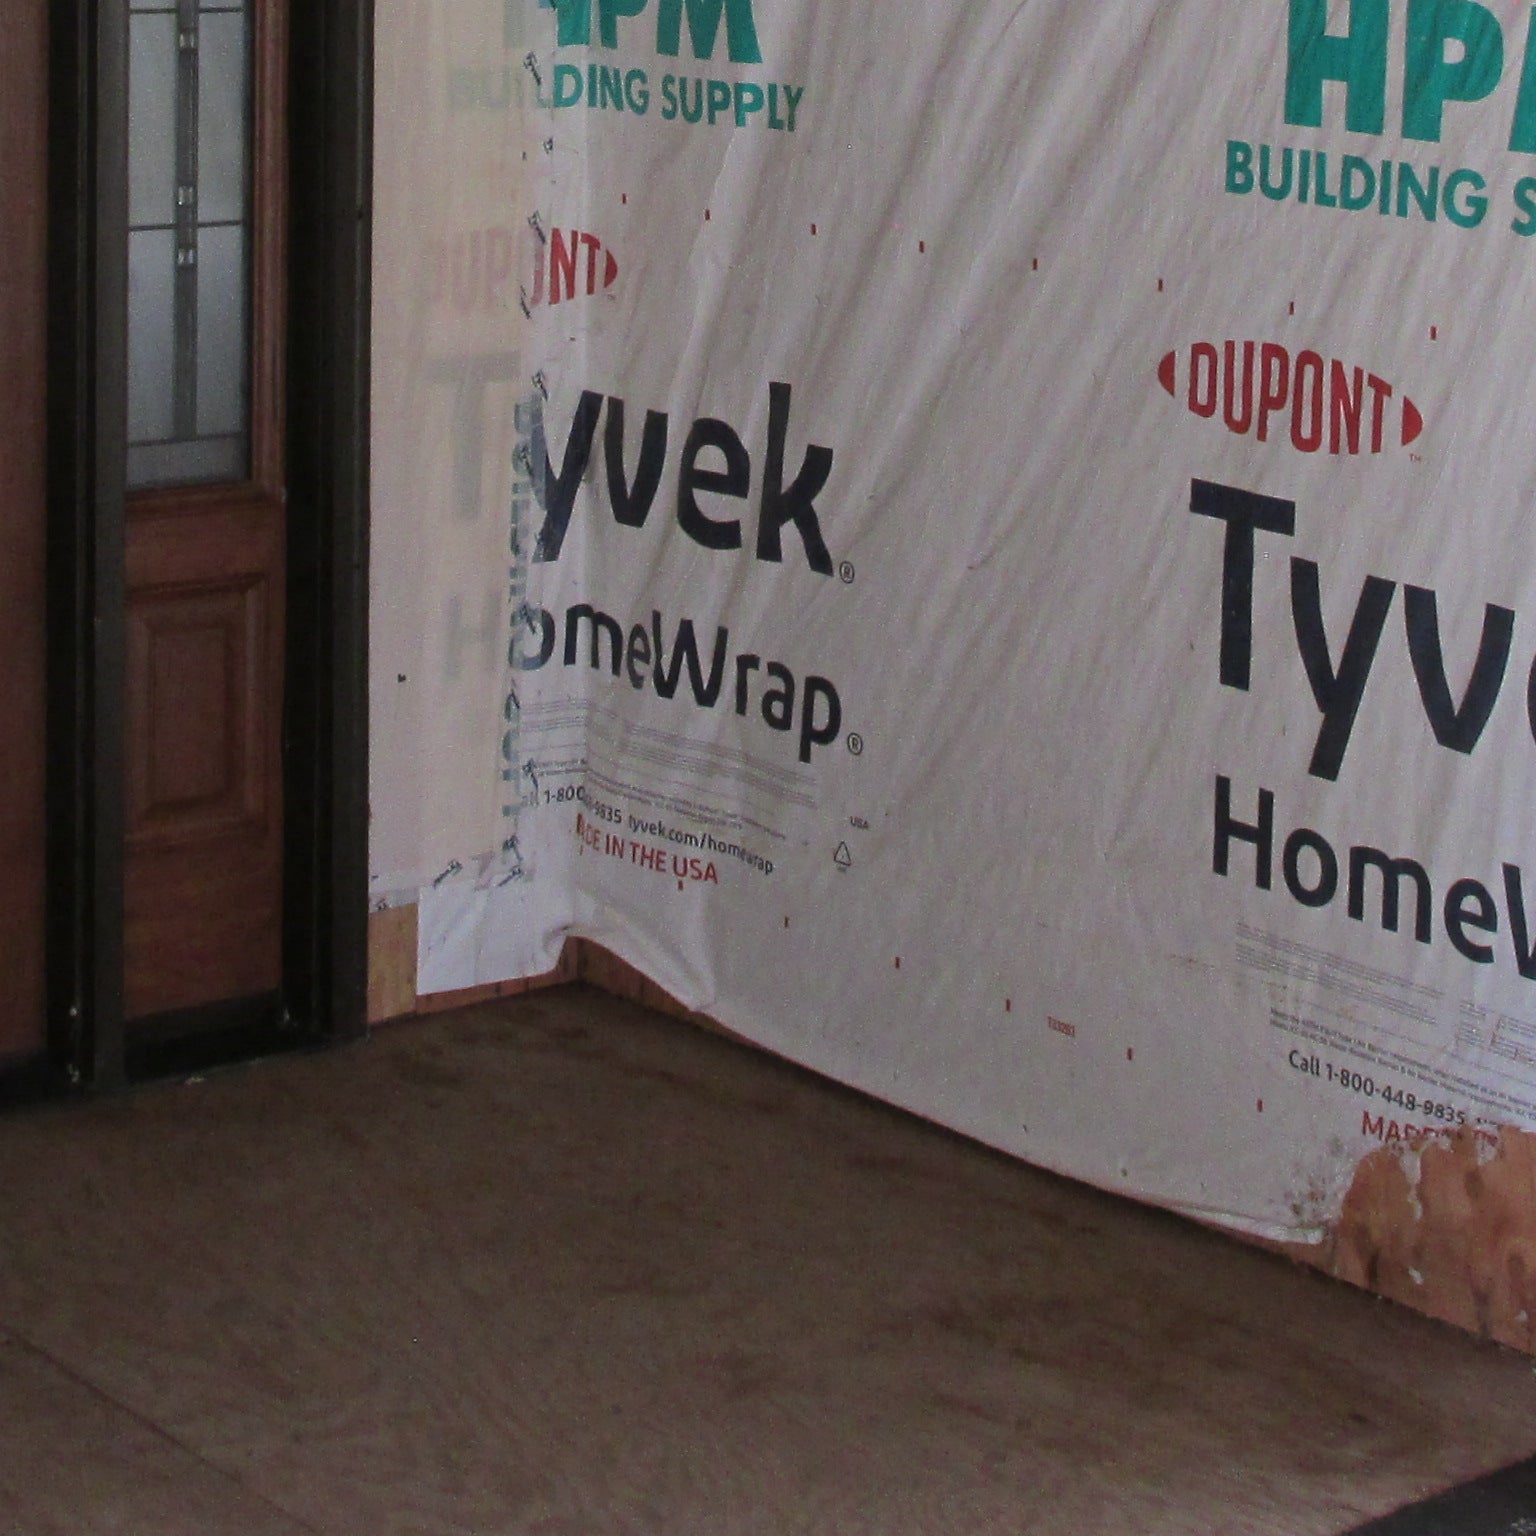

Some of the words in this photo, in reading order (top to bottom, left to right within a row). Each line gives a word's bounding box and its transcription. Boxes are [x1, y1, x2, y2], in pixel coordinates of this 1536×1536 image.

[660, 75, 805, 133] SUPPLY
[1224, 140, 1490, 230] BUILDING
[1188, 339, 1393, 455] DUPONT
[530, 381, 835, 578] yvek
[509, 602, 842, 764] omeWrap
[604, 833, 625, 860] IN
[629, 841, 668, 874] THE
[672, 854, 719, 885] USA
[1288, 1049, 1321, 1077] Call
[1324, 1063, 1465, 1125] 1-800-448-9835
